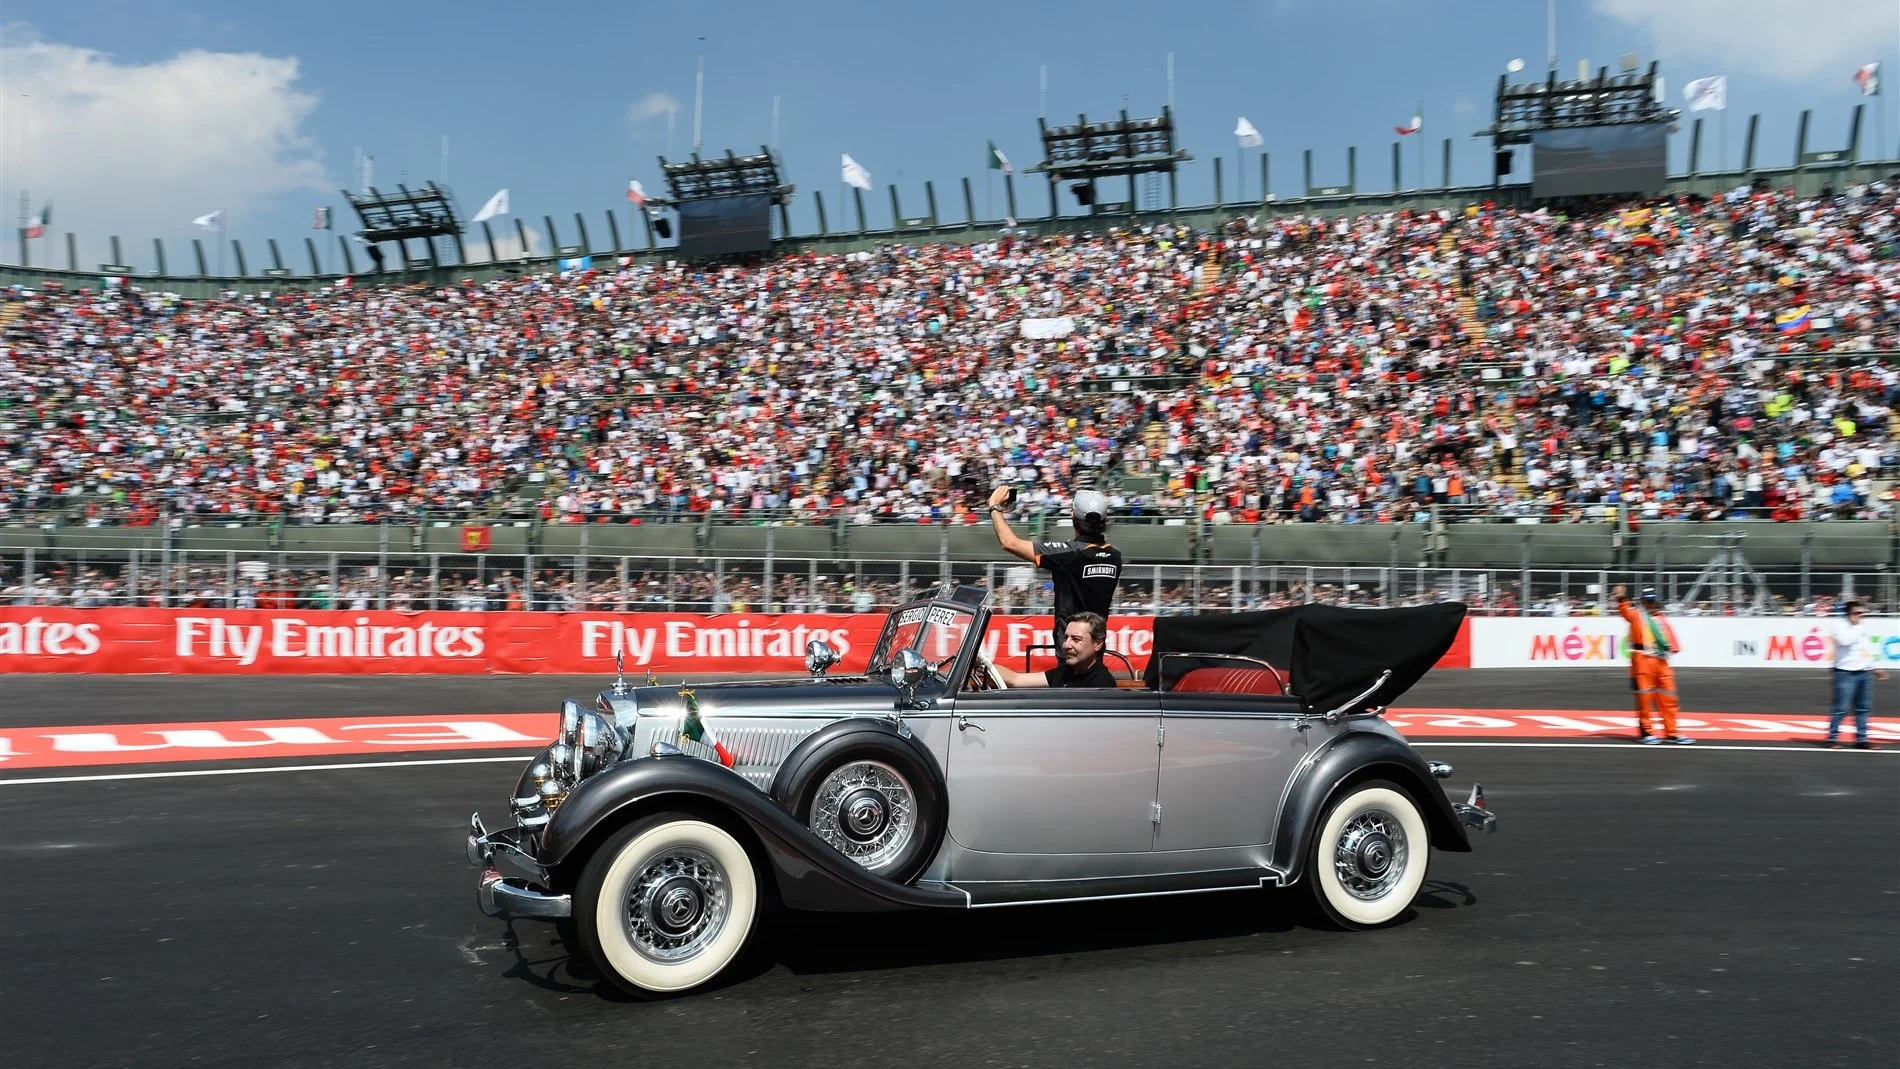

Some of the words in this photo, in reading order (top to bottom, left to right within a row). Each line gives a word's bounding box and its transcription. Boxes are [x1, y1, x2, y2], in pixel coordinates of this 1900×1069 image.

[1086, 566, 1116, 576] SMIRNOFF
[899, 608, 925, 624] SERGIO
[929, 608, 955, 626] PEREZ
[175, 617, 263, 665] Fly
[271, 617, 485, 657] Emirates
[580, 620, 656, 666] Fly
